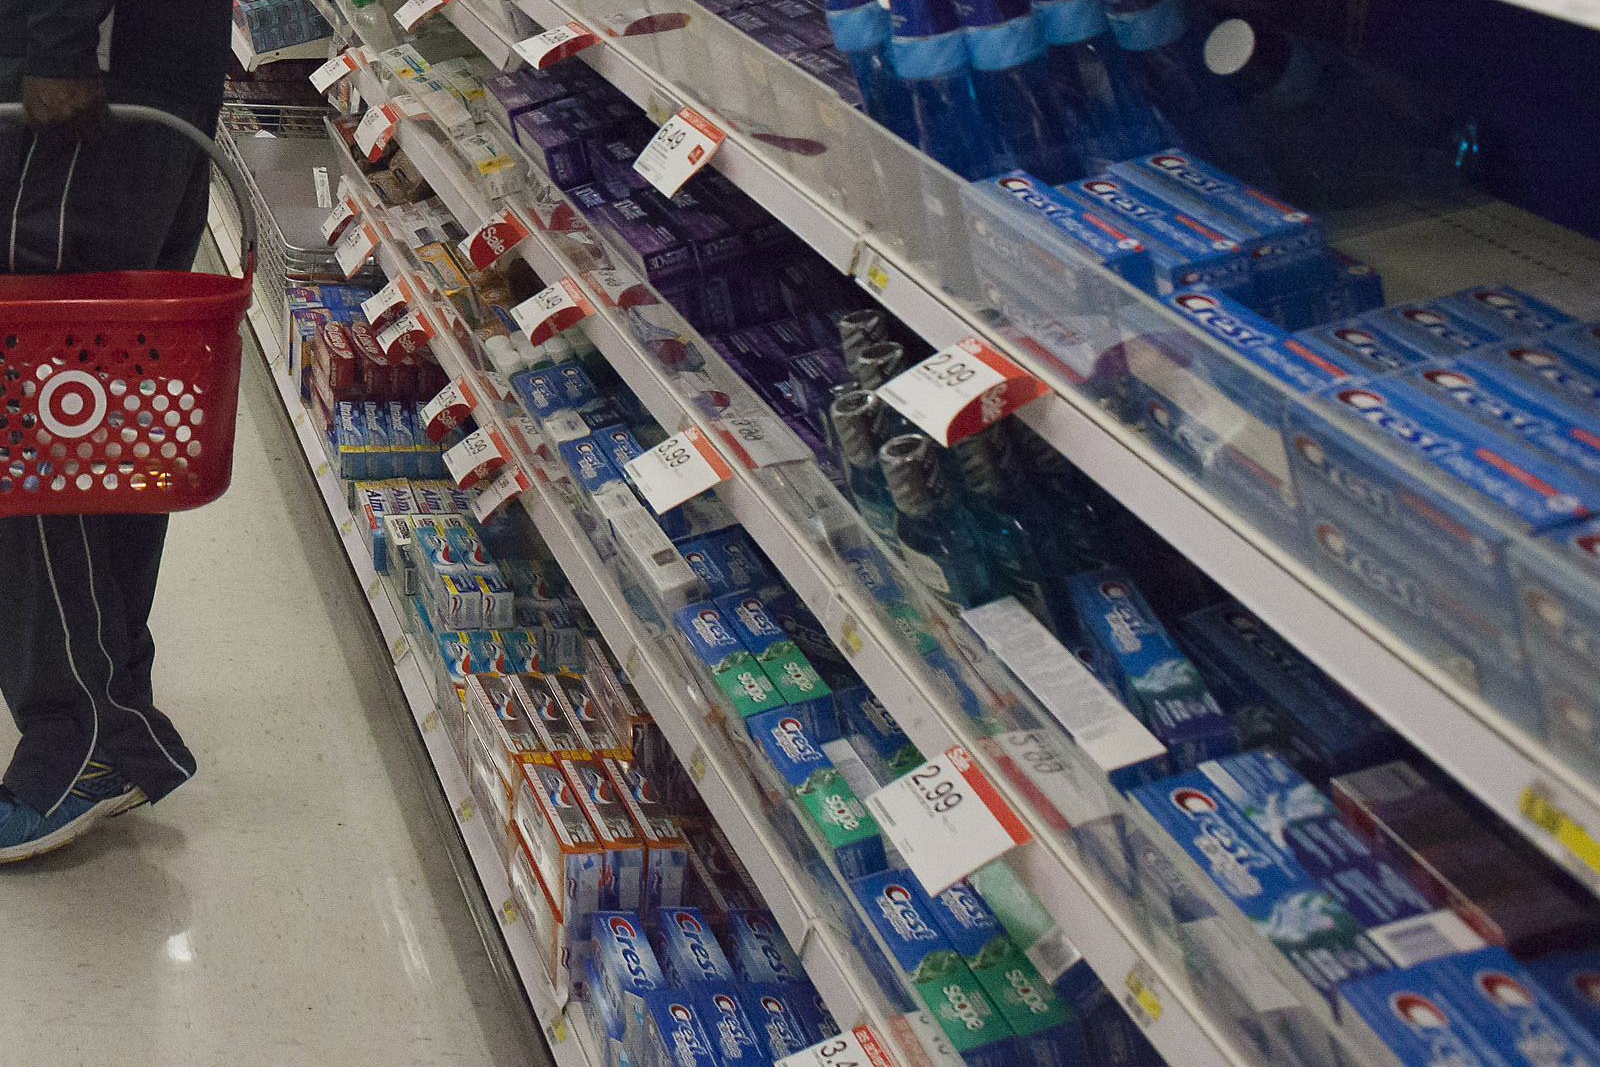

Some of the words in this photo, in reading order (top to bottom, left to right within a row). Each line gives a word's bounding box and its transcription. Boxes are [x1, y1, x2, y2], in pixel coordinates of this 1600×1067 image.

[998, 176, 1076, 221] Crest
[1082, 180, 1168, 222] Crest
[482, 226, 505, 255] Sale
[1175, 293, 1274, 347] Crest
[657, 438, 691, 467] 3.99
[699, 609, 736, 647] Crest
[741, 598, 783, 636] Crest
[737, 671, 768, 703] scope
[784, 661, 814, 692] scope
[778, 717, 823, 763] Crest
[911, 764, 963, 813] 2.99
[825, 794, 860, 831] scope
[1170, 787, 1271, 867] Crest
[883, 885, 938, 940] Crest
[948, 877, 995, 929] rest
[609, 916, 656, 991] Crest
[674, 912, 727, 982] Crest
[943, 984, 985, 1031] scope
[1005, 969, 1049, 1014] scope
[669, 1003, 710, 1057] Crest
[713, 994, 753, 1046] Crest
